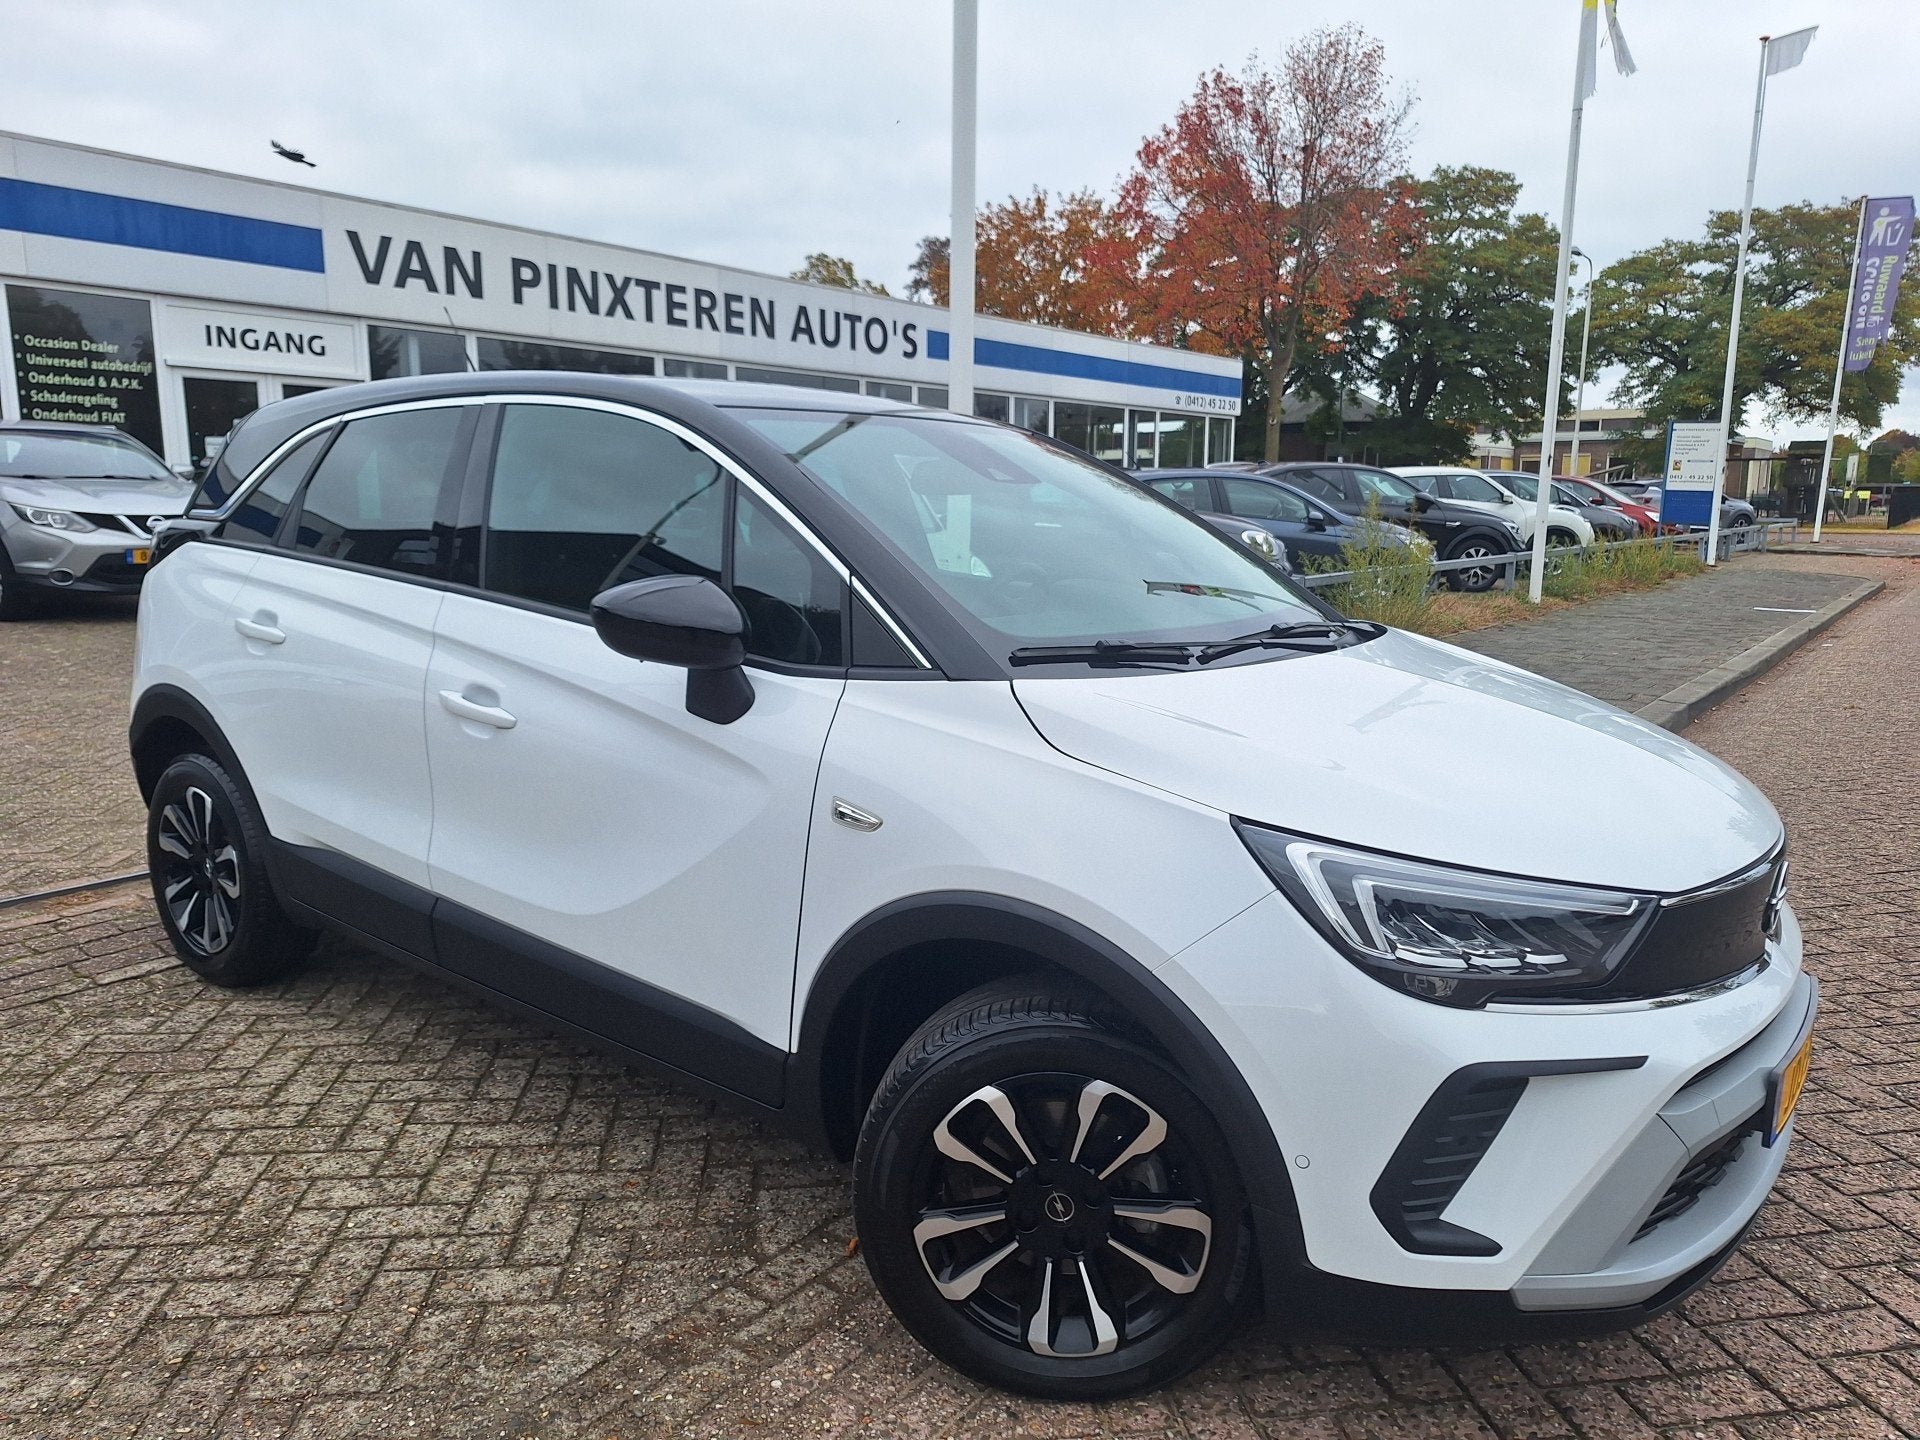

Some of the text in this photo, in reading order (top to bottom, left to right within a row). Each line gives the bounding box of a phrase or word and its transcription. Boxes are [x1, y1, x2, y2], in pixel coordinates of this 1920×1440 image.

[345, 229, 918, 359] VAN PINXTEREN AUTO'S
[1870, 255, 1899, 313] Ruwaard
[23, 334, 119, 353] Occasion Dealer
[204, 324, 326, 356] INGANG
[26, 352, 153, 376] Universeel autobedrijf
[28, 371, 144, 390] Onderhoud & A.P.K.
[30, 389, 119, 409] Schaderegeling
[1184, 394, 1236, 411] (0412) 45 22 50
[31, 407, 127, 424] Onderhoud FIAT
